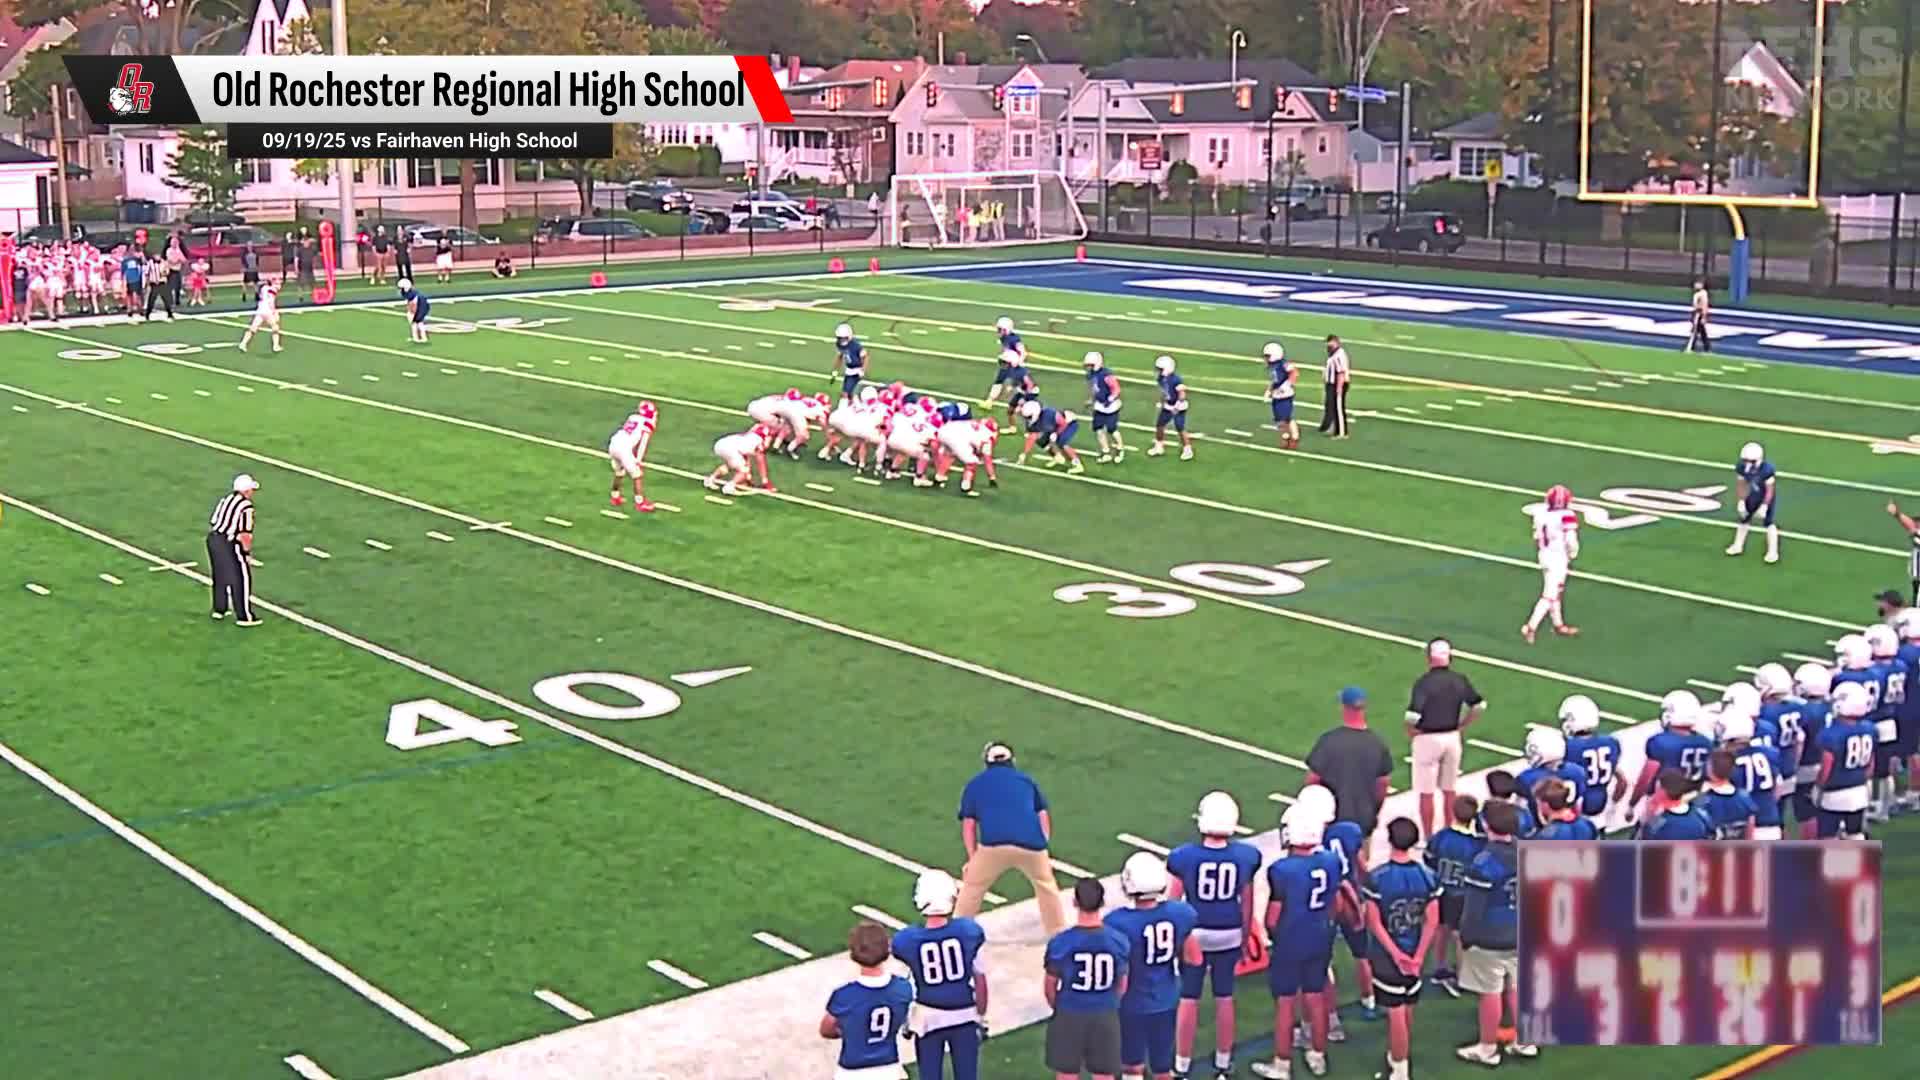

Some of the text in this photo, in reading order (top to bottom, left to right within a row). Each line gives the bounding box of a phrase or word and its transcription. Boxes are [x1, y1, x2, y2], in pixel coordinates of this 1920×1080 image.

[1053, 561, 1306, 618] 30
[384, 670, 682, 752] 40
[1582, 746, 1612, 786] 35
[1735, 752, 1774, 791] 79
[1845, 734, 1873, 770] 88
[1197, 862, 1236, 900] 60
[1309, 868, 1328, 910] 2
[920, 938, 965, 985] 80
[1143, 920, 1175, 965] 19
[1071, 953, 1114, 991] 30
[867, 1006, 891, 1044] 9
